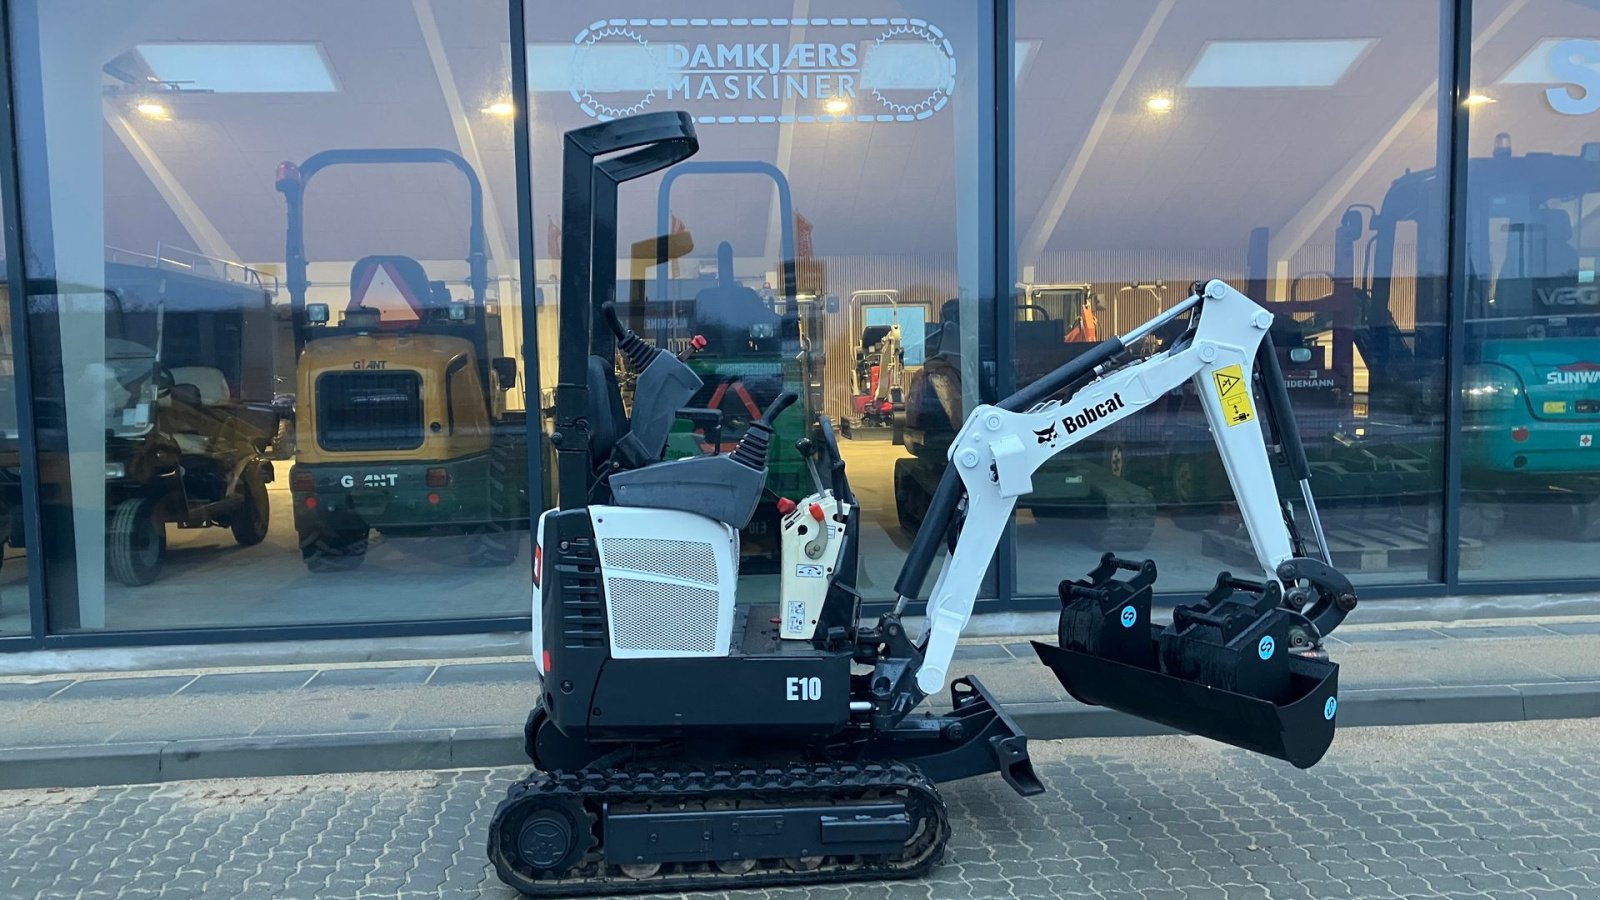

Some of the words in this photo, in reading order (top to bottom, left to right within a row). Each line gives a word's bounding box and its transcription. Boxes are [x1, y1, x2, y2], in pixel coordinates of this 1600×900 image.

[667, 43, 857, 73] DAMKJÆRS
[667, 75, 857, 99] MASKINER
[353, 360, 387, 369] GIANT
[1062, 392, 1125, 435] Bobcat
[786, 677, 822, 701] E10
